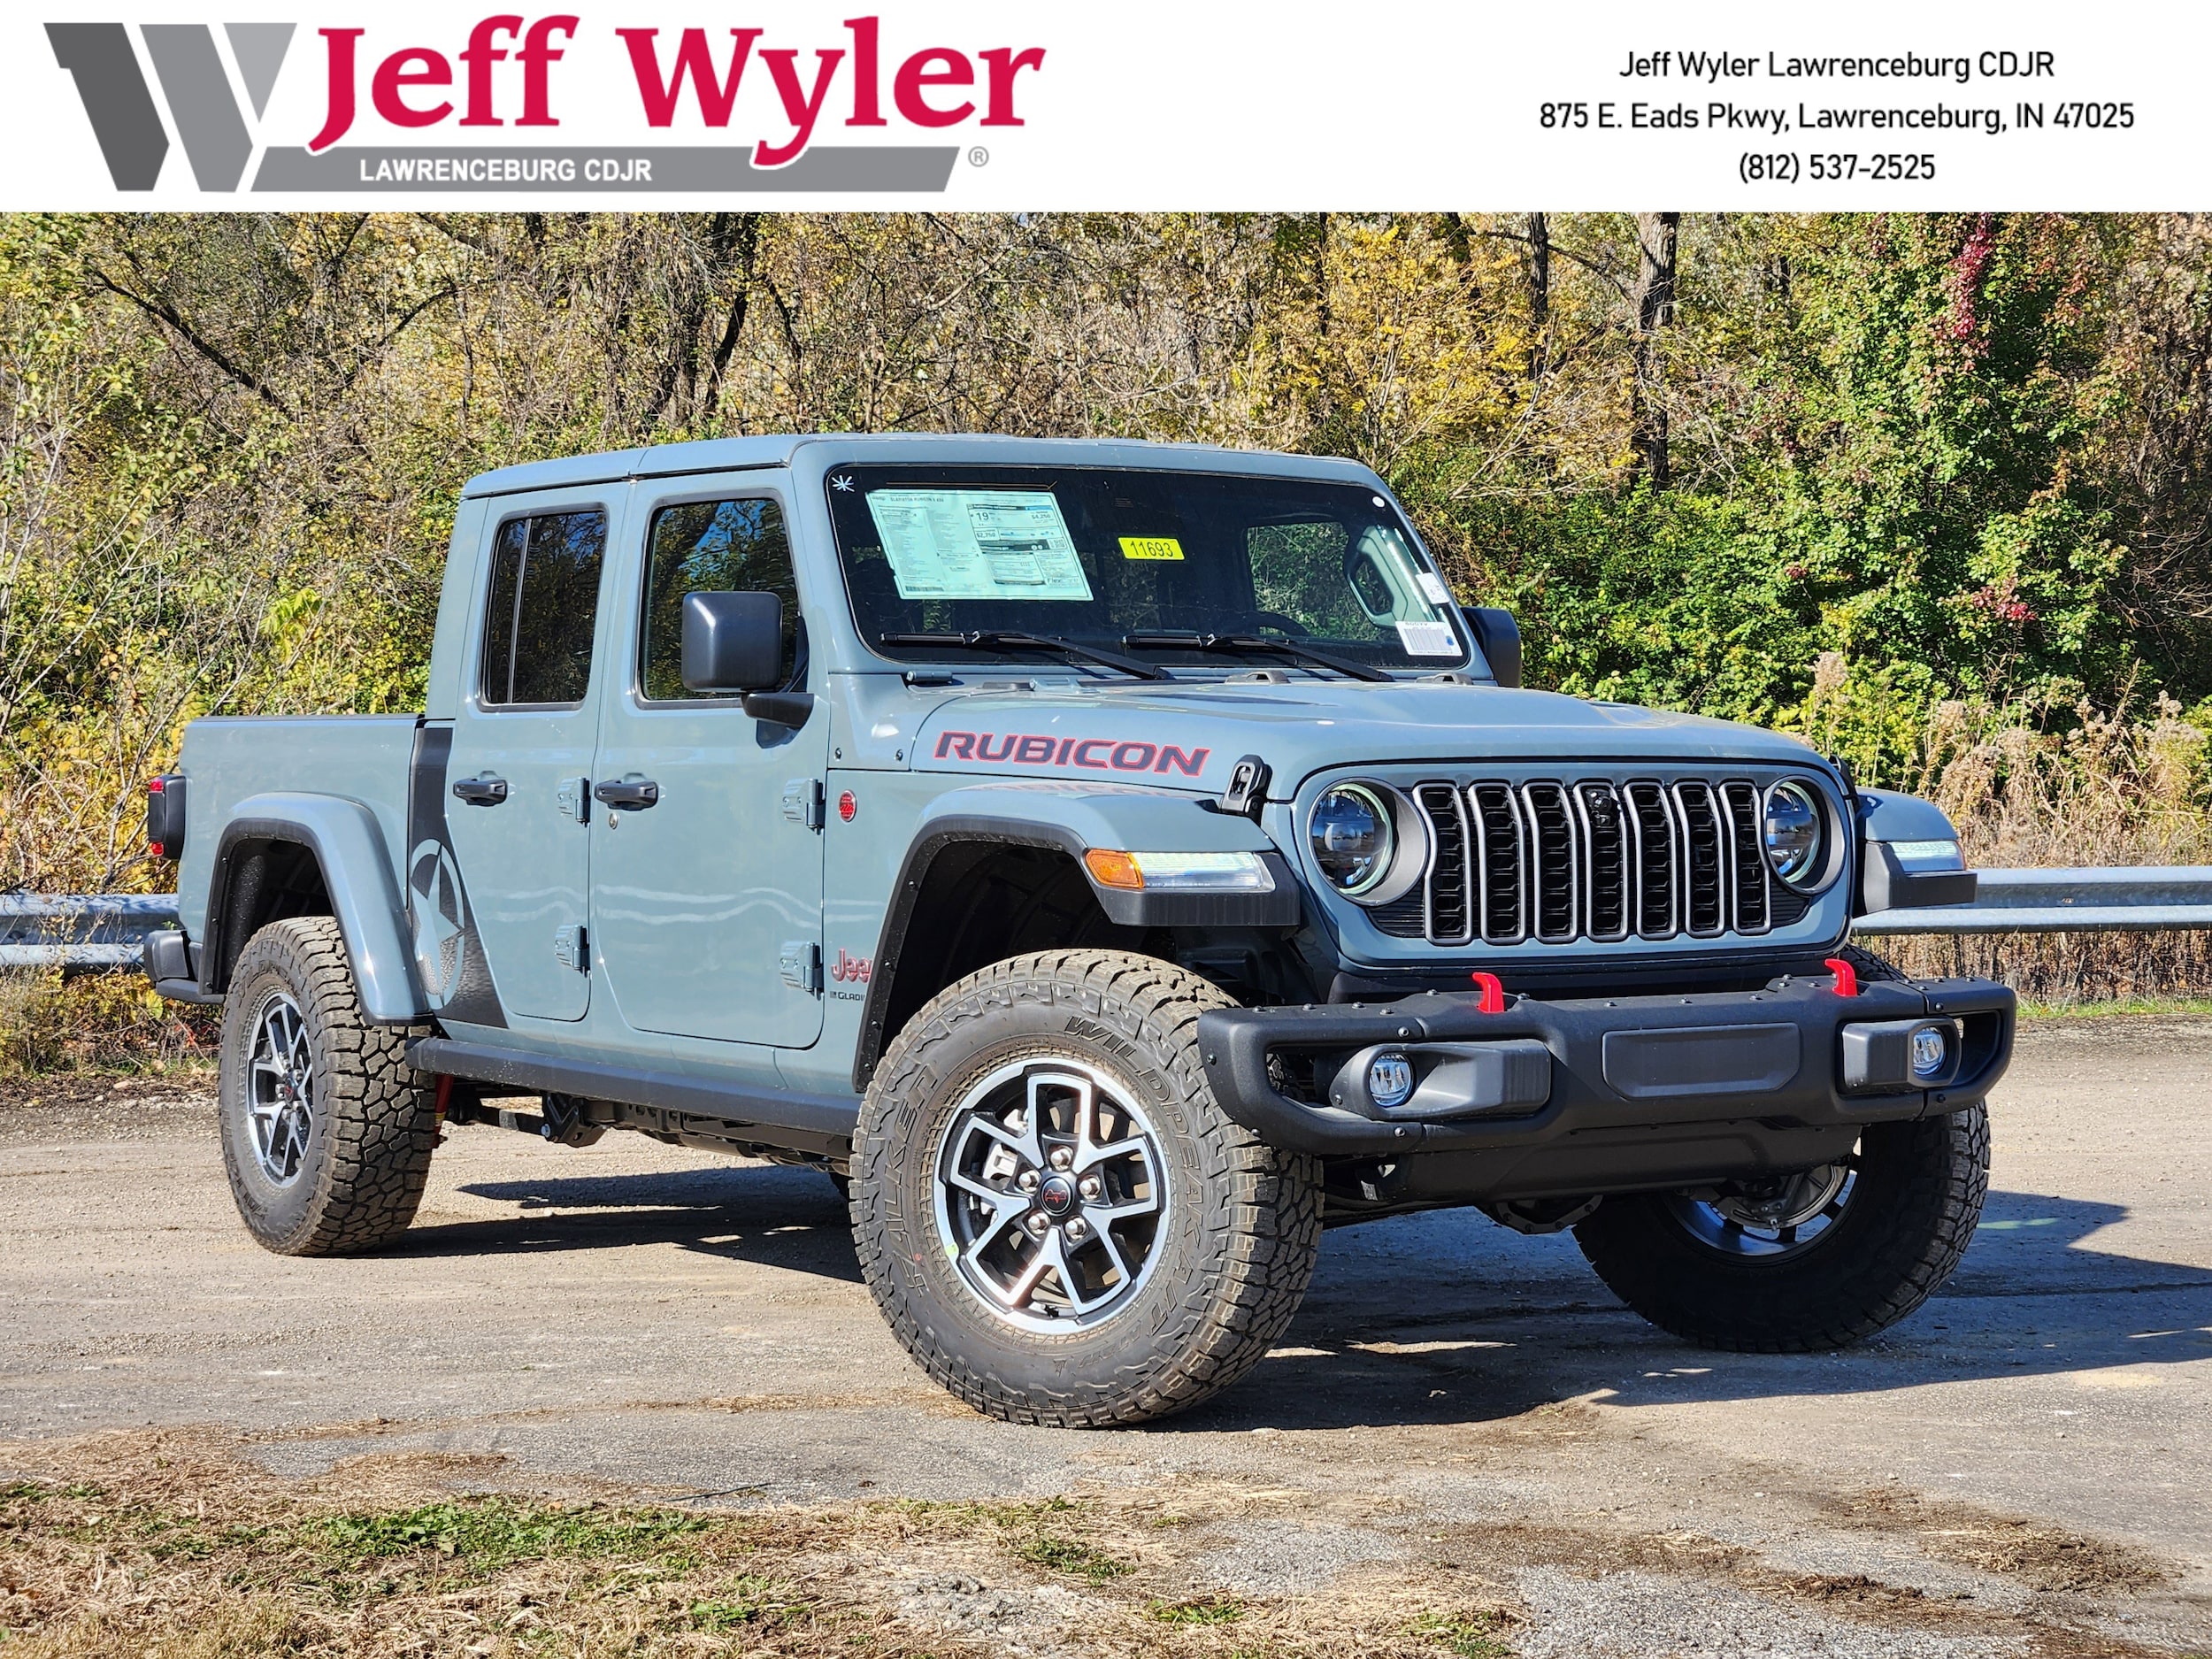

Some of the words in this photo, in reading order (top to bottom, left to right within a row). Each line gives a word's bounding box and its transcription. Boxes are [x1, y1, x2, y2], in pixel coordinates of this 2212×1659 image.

[976, 511, 989, 521] 19
[1130, 540, 1173, 557] 11693
[933, 730, 1211, 777] RUBICON
[831, 948, 873, 984] Jee
[837, 991, 865, 1002] GLADI
[1064, 1016, 1203, 1249] WILDPEAK
